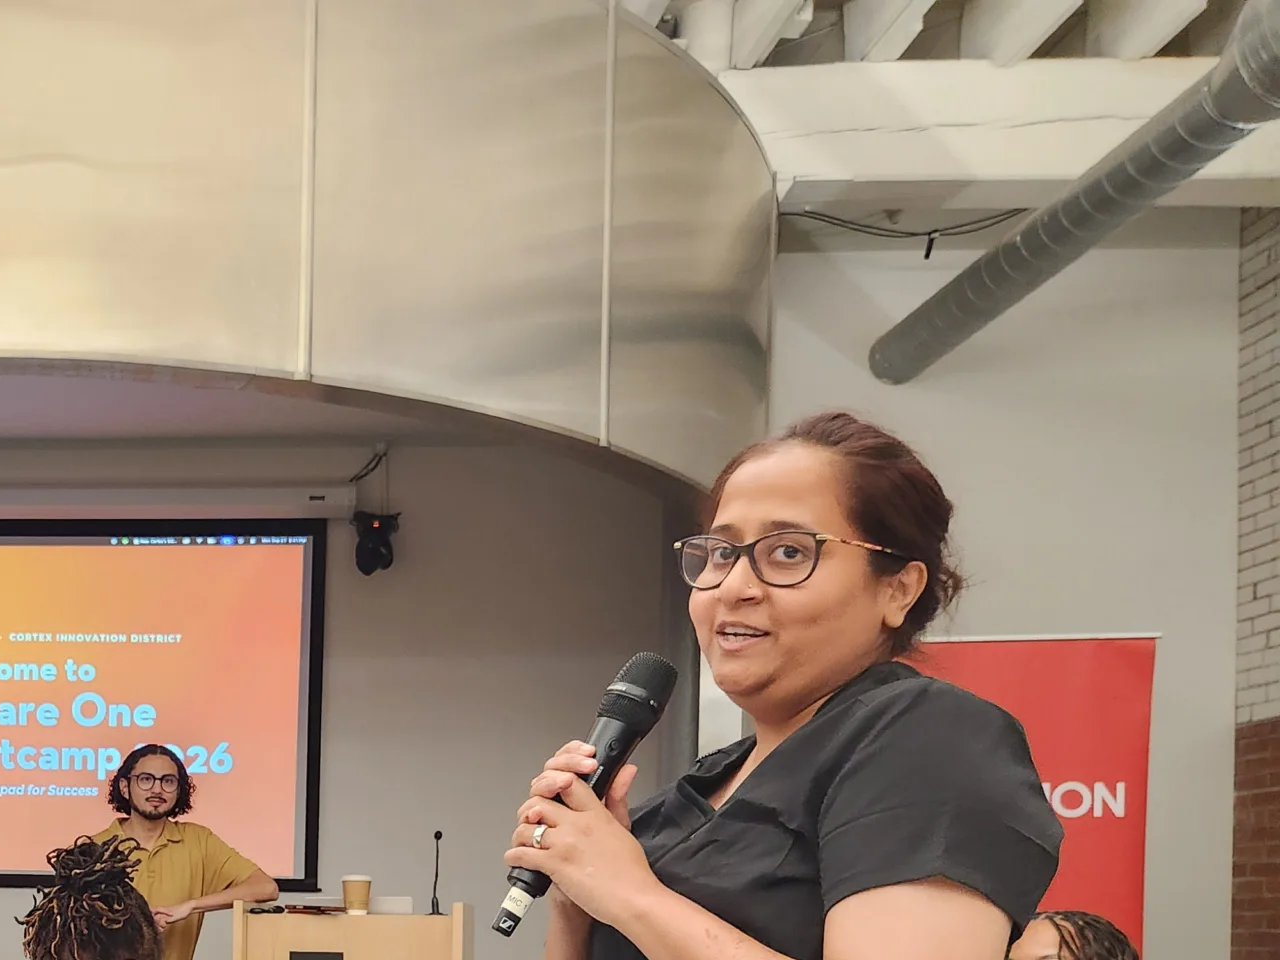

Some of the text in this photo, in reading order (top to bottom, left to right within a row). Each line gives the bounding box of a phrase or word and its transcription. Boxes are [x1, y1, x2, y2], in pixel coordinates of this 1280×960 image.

[9, 633, 52, 642] CORTEX
[56, 633, 126, 643] INNOVATION
[131, 634, 182, 643] DISTRICT
[65, 659, 96, 682] to
[72, 692, 157, 727] One
[133, 742, 233, 774] 26
[27, 784, 45, 796] for
[47, 785, 99, 797] Success
